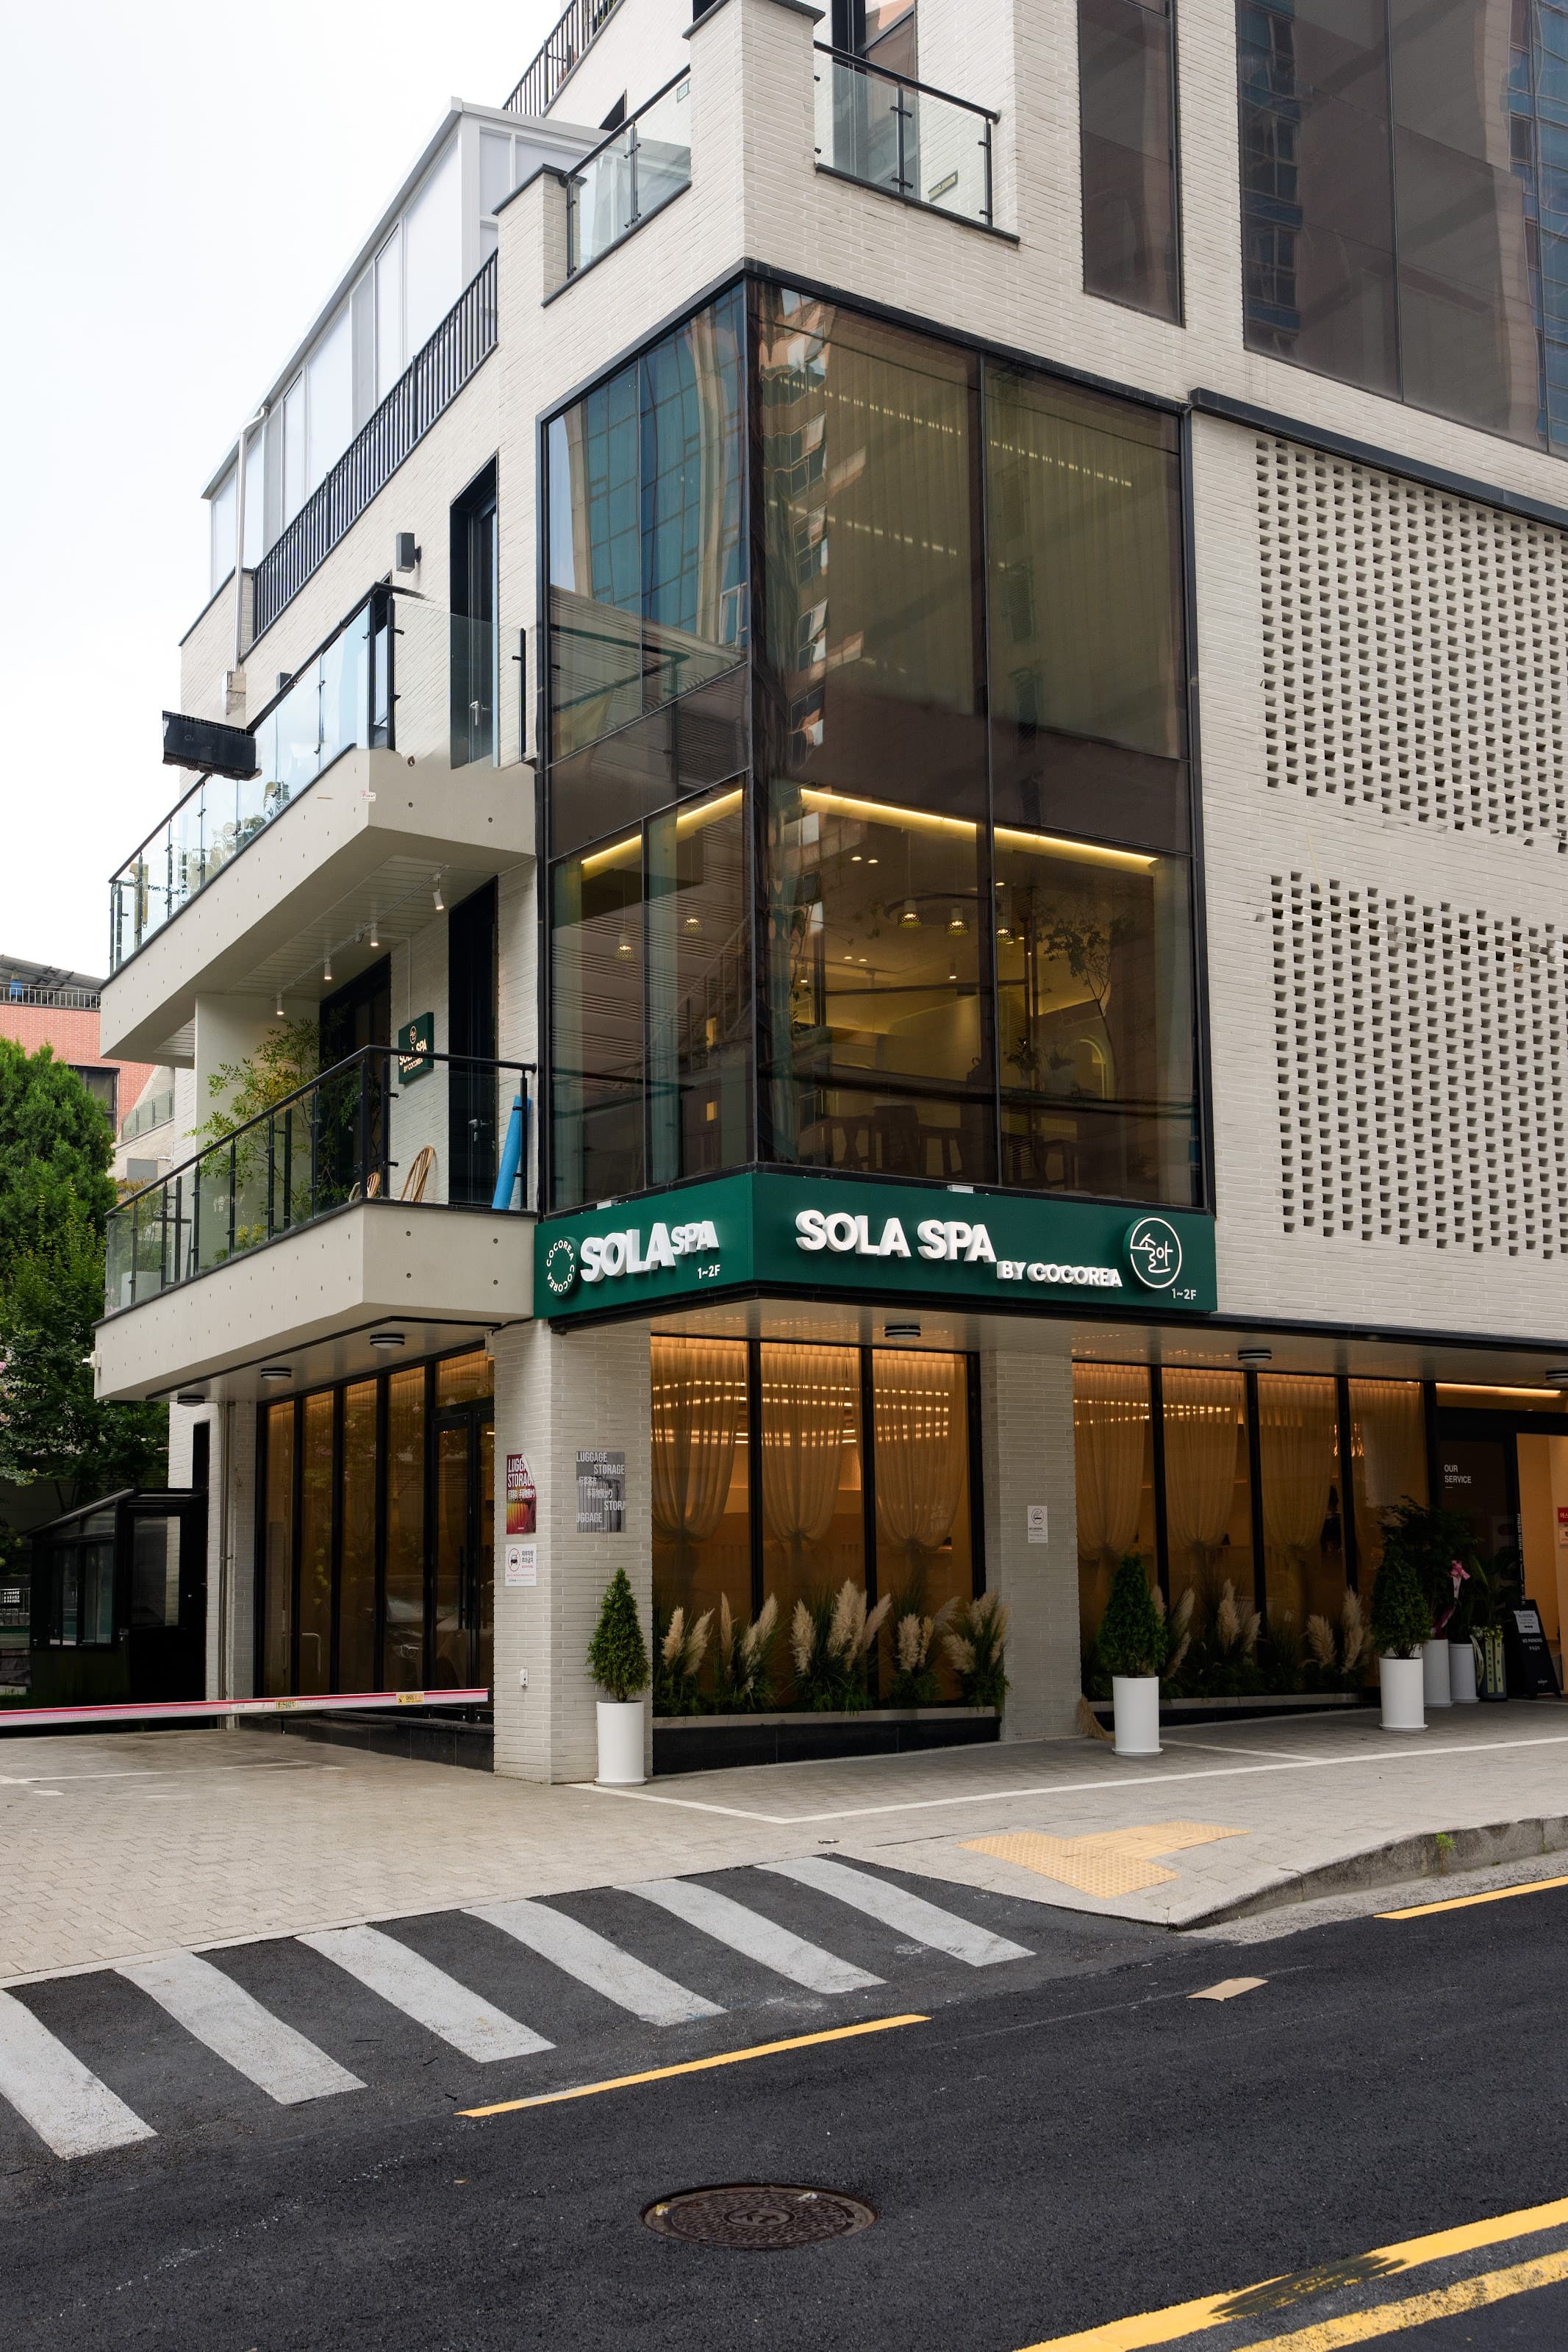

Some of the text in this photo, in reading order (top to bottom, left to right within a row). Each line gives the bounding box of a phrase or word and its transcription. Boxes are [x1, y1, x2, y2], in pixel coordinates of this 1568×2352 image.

[795, 1209, 997, 1263] SOLA SPA
[581, 1220, 719, 1282] SOLA SPA
[697, 1264, 720, 1279] 1~2F
[996, 1261, 1123, 1287] BY COCOREA
[1172, 1287, 1197, 1300] 1~2F
[576, 1452, 608, 1462] LUGGAGE
[594, 1464, 625, 1475] STORAGE
[1444, 1464, 1458, 1473] OUR
[1444, 1475, 1472, 1484] SERVICE
